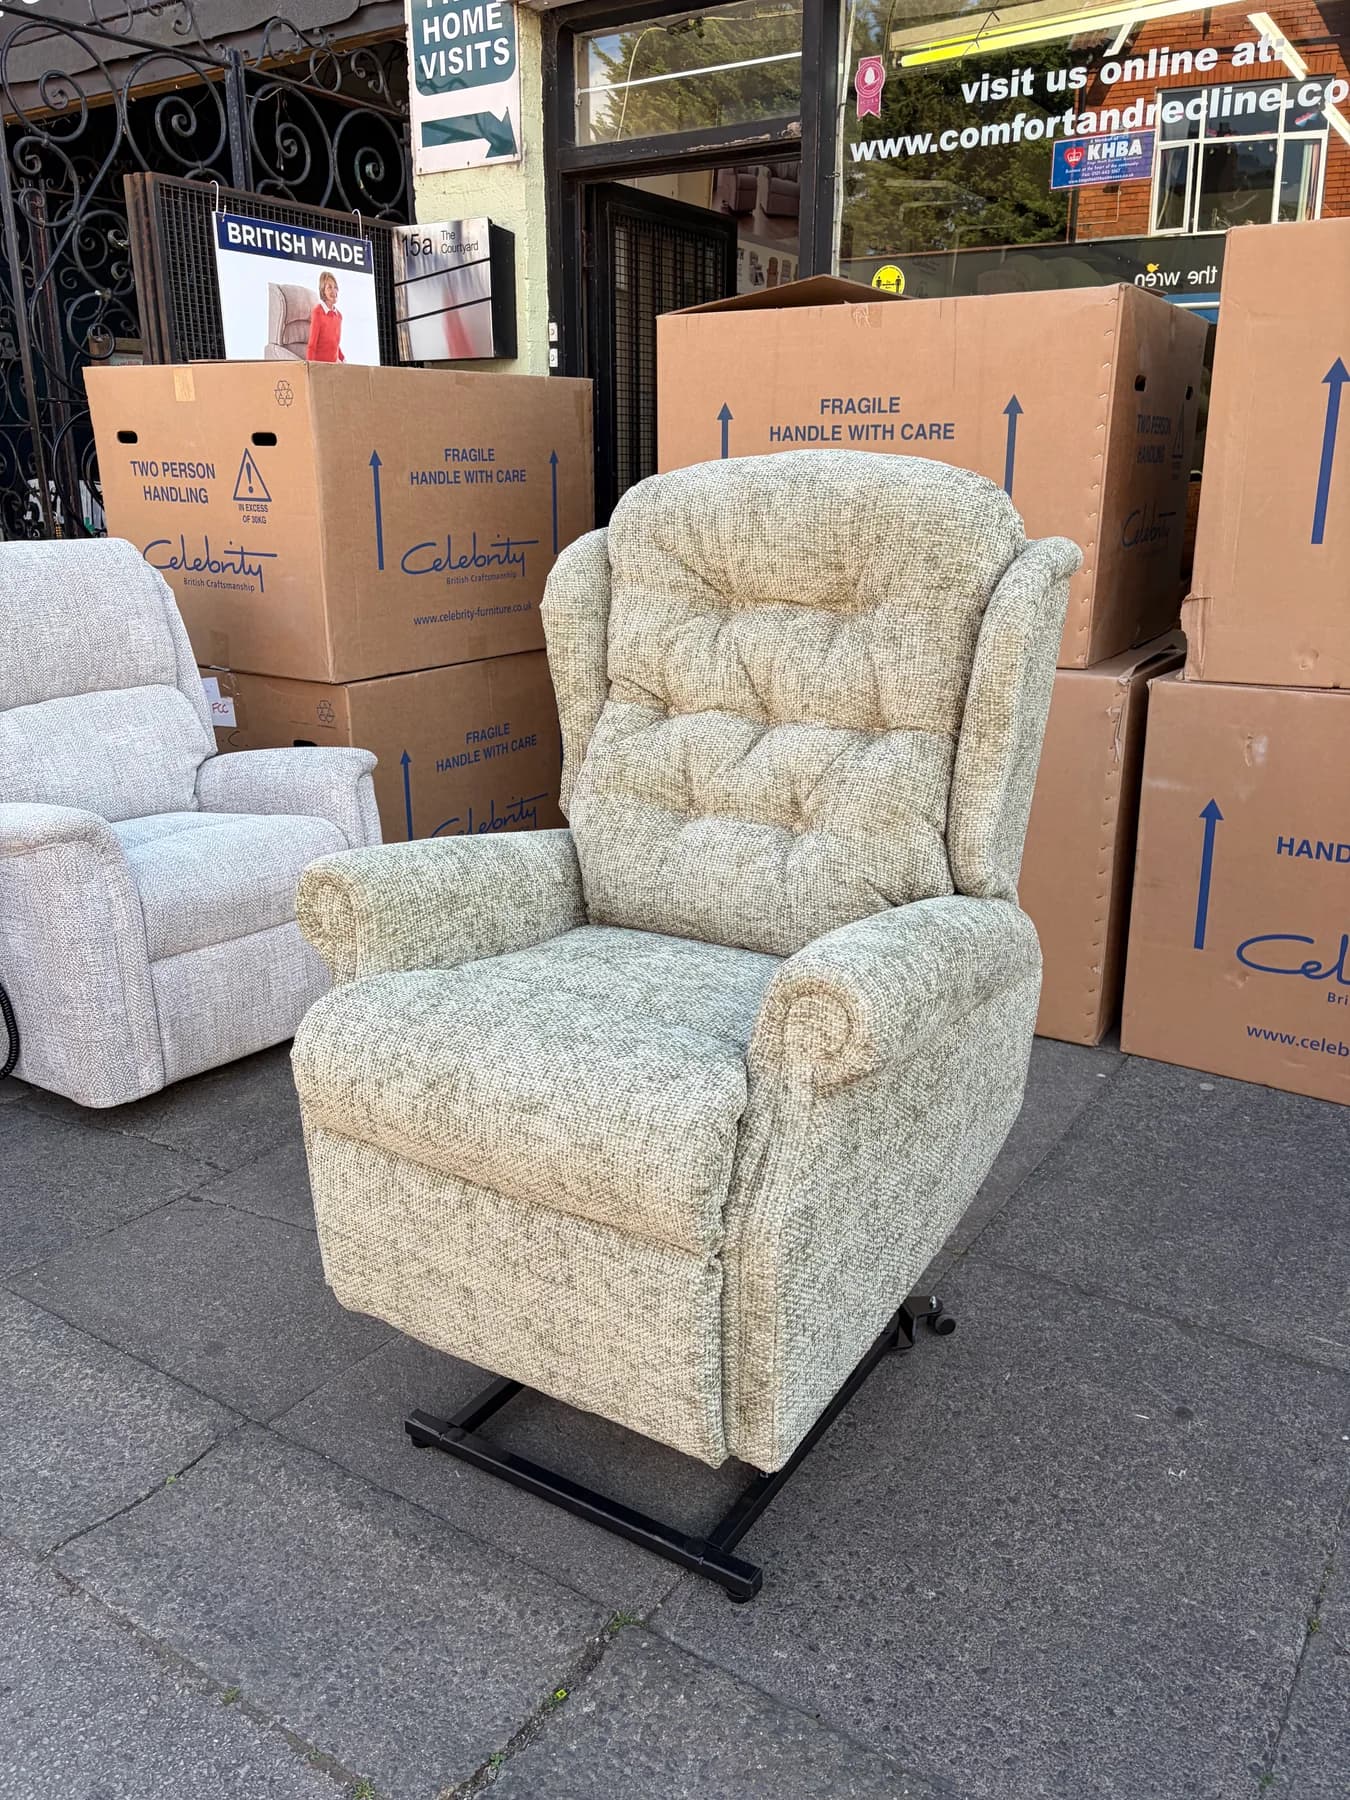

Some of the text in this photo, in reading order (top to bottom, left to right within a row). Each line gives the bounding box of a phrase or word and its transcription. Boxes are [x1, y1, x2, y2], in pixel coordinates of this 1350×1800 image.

[422, 2, 504, 45] HOME
[419, 37, 510, 80] VISITS
[961, 66, 1034, 104] visit
[1046, 66, 1088, 93] us
[1099, 46, 1219, 85] online
[1087, 138, 1143, 161] KHBA
[227, 222, 366, 267] BRITISH MADE
[401, 233, 434, 258] 15a
[440, 230, 456, 241] The
[440, 240, 480, 256] Courtyard
[820, 396, 901, 415] FRAGILE
[769, 422, 956, 442] HANDLE WITH CARE
[444, 448, 496, 463] FRAGILE
[130, 460, 216, 480] TWO PERSON
[410, 469, 527, 486] HANDLE WITH CARE
[143, 485, 209, 504] HANDLING
[238, 503, 269, 513] IN EXCESS
[242, 515, 251, 523] OF
[143, 534, 278, 593] Celebrity
[401, 531, 540, 577] Celebrity
[183, 577, 256, 593] British Craftsmanship
[446, 570, 518, 585] British Craftsmanship
[413, 602, 532, 626] www.celebrity-furniture.co.uk
[466, 723, 511, 745] FRAGILE
[436, 734, 538, 773] HANDLE WITH CARE
[1276, 836, 1350, 863] HAND
[1246, 1025, 1350, 1057] www.celeb
